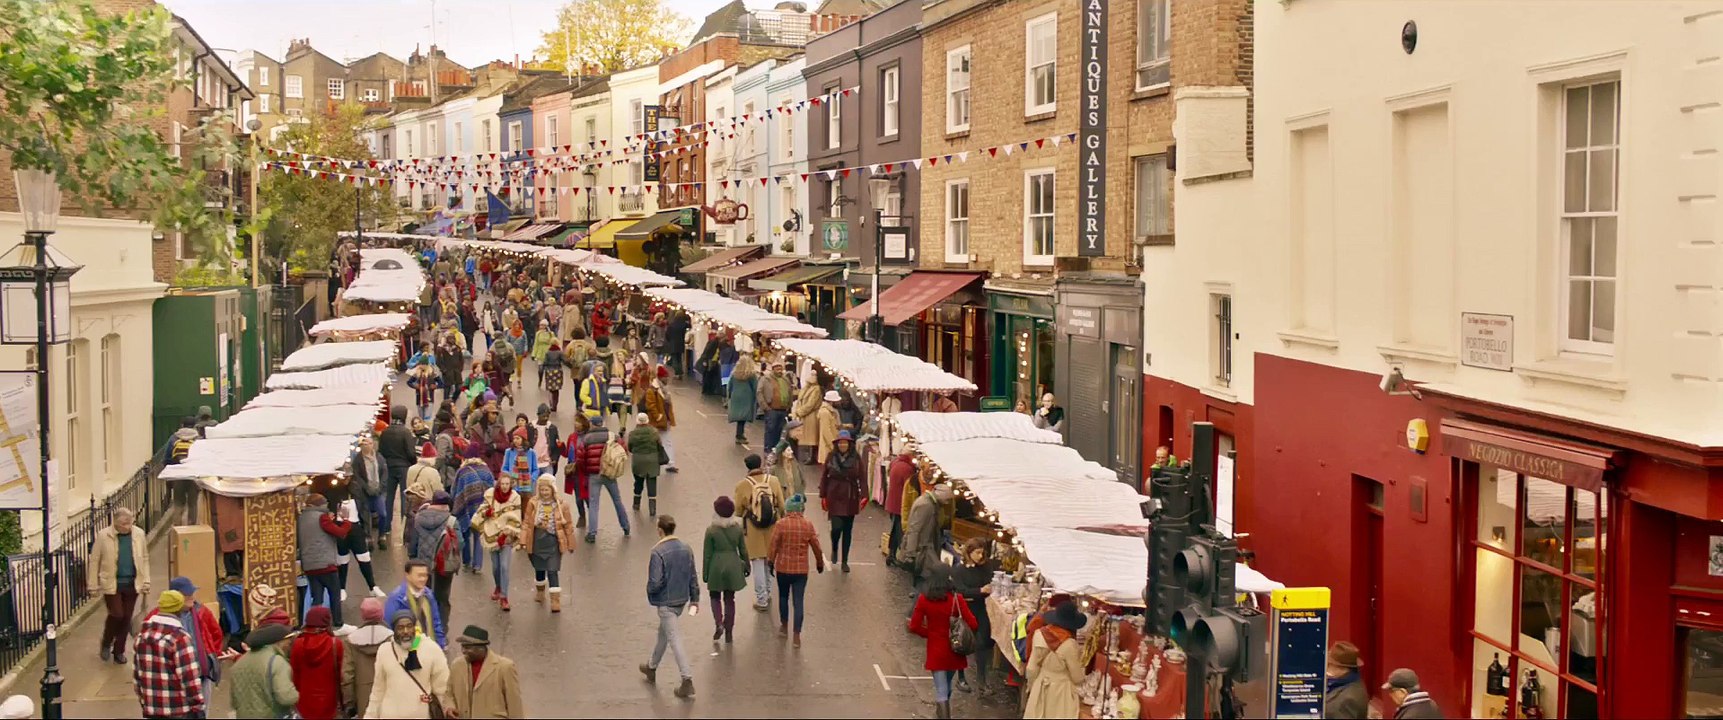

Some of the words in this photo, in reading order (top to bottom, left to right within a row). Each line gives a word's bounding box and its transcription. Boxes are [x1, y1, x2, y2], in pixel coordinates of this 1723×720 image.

[1087, 0, 1102, 126] ANTIQUES
[647, 109, 657, 131] THE
[1086, 135, 1101, 249] GALLERY
[1465, 337, 1507, 352] PORTOBELLO
[1468, 442, 1512, 468] NEGOZIO
[1514, 453, 1563, 480] CLASSICA
